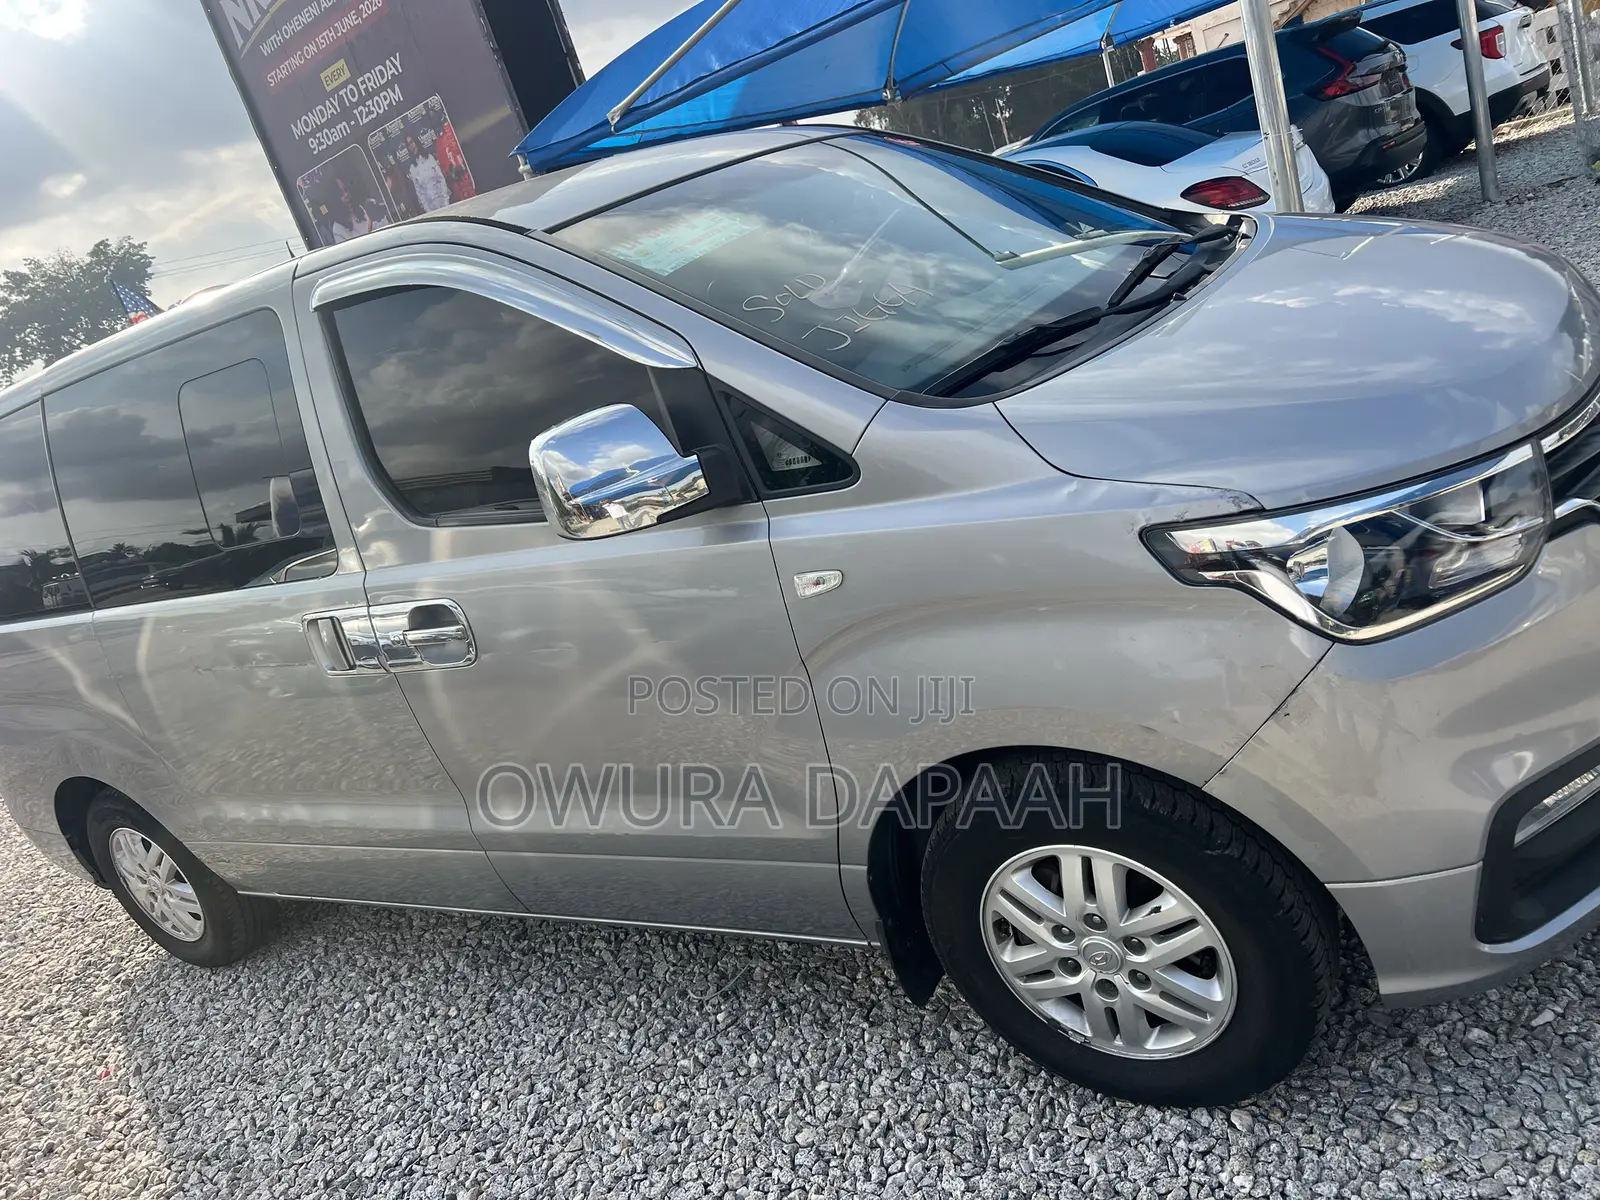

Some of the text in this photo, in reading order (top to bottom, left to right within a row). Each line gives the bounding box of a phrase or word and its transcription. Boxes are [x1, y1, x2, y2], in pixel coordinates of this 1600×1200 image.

[260, 30, 284, 56] WITH
[282, 3, 321, 40] OHENENI
[266, 51, 305, 87] STARTING
[303, 42, 318, 60] ON
[315, 26, 337, 50] 15TH
[334, 10, 362, 36] JUNE,
[290, 94, 341, 140] MONDAY
[339, 84, 358, 107] TO
[357, 52, 403, 96] FRIDAY
[323, 63, 347, 88] EVERY
[308, 120, 351, 155] 9:30am
[353, 83, 403, 126] 12:30PM
